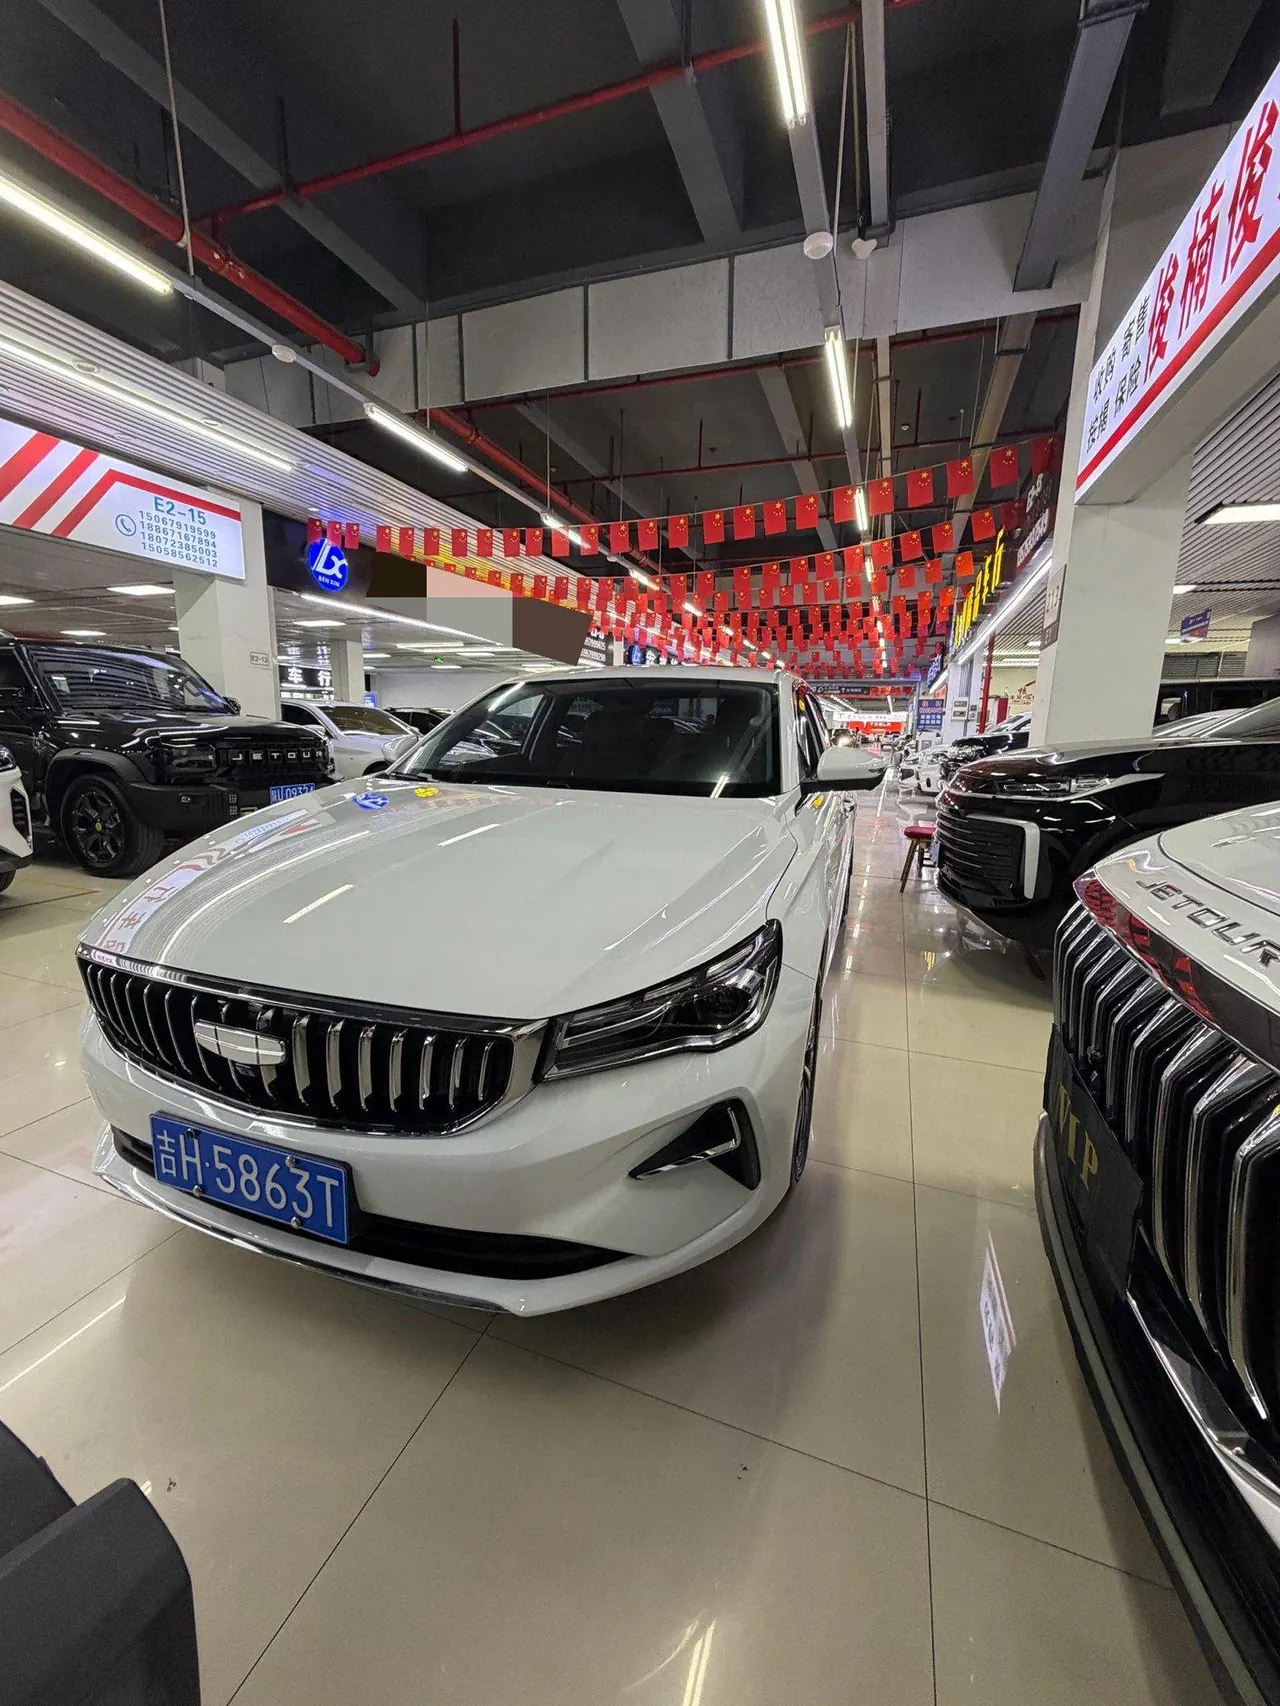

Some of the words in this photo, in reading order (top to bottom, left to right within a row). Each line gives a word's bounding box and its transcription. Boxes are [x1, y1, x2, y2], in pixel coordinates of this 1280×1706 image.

[1114, 355, 1141, 418] 保险
[139, 510, 216, 539] 15067919599
[153, 496, 207, 526] E2-15
[139, 521, 217, 549] 18867167894
[140, 531, 217, 558] 18072385003
[141, 542, 218, 568] 15058562512
[287, 667, 332, 686] 车行
[232, 751, 323, 761] JETOUR
[1136, 879, 1280, 968] JETOUR
